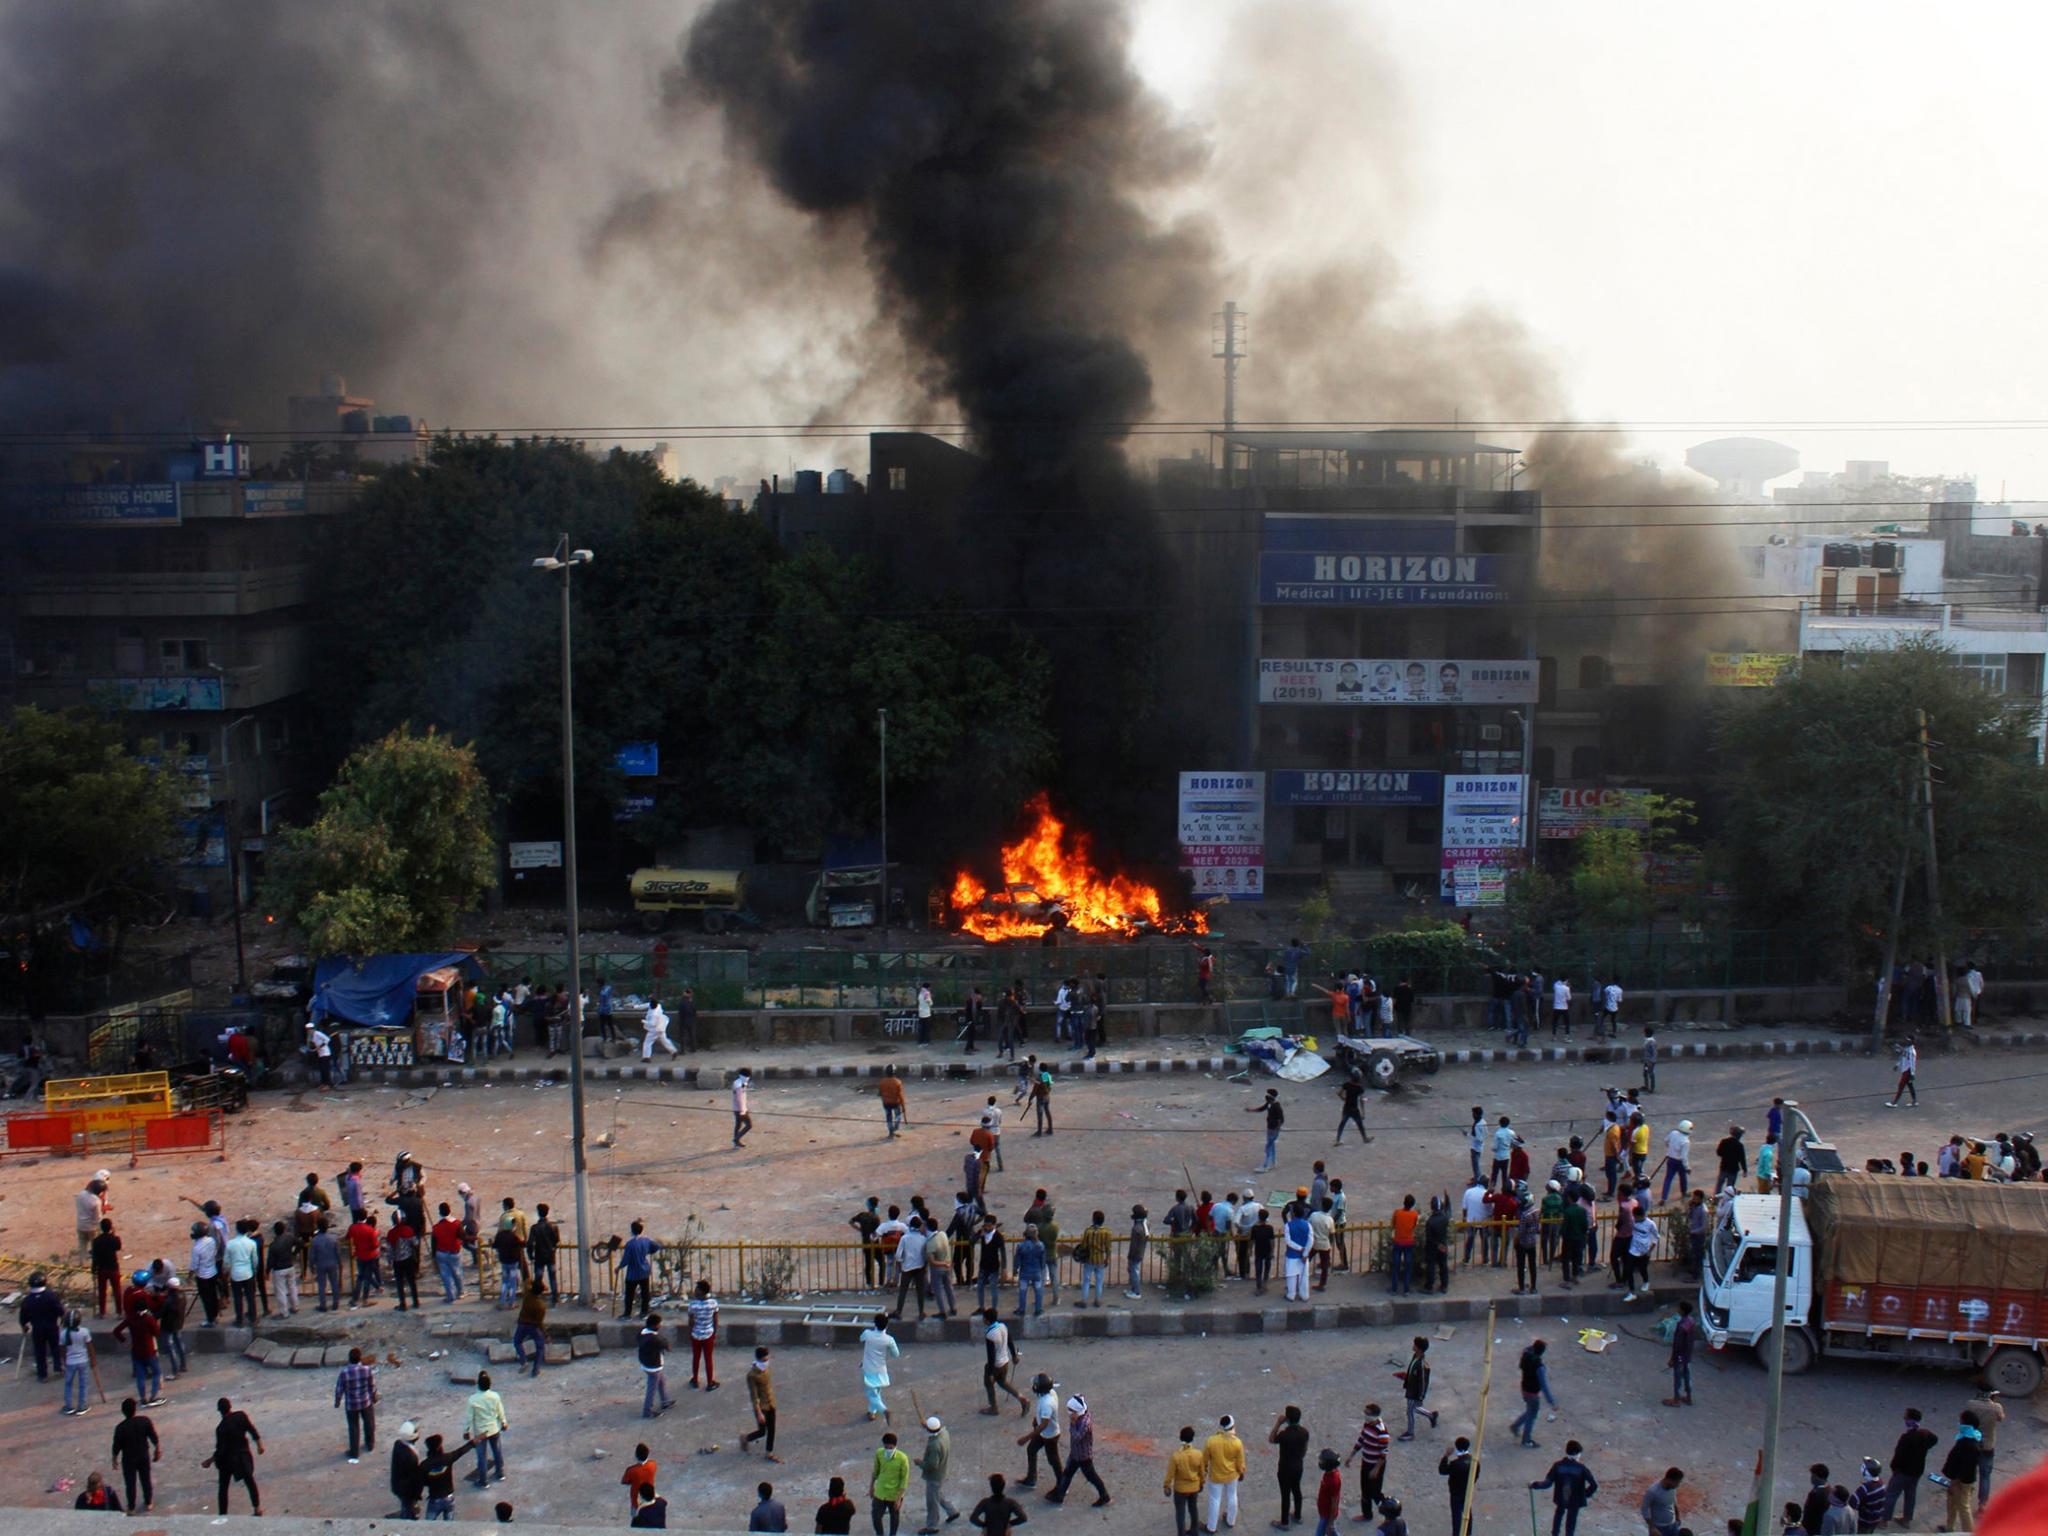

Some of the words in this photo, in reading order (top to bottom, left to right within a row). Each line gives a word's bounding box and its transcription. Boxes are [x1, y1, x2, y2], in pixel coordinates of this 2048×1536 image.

[205, 445, 233, 470] H
[133, 490, 174, 503] HOME
[1314, 556, 1477, 582] HORIZON
[1276, 587, 1334, 600] Medical
[1350, 588, 1405, 601] IIT-JEE
[1261, 661, 1334, 673] RESULTS
[1279, 675, 1317, 685] NEET
[1471, 670, 1531, 681] HORIZON
[1273, 687, 1322, 701] (2019)
[1190, 778, 1254, 790] HORIZON
[1303, 773, 1411, 791] HORIZON
[1455, 782, 1518, 793] HORIZON
[1184, 846, 1215, 855] CRASH
[1221, 846, 1261, 855] COURSE
[1445, 849, 1478, 857] CRASH
[1193, 857, 1219, 865] NEET
[1225, 857, 1249, 865] 2020
[103, 1111, 131, 1121] POLICE
